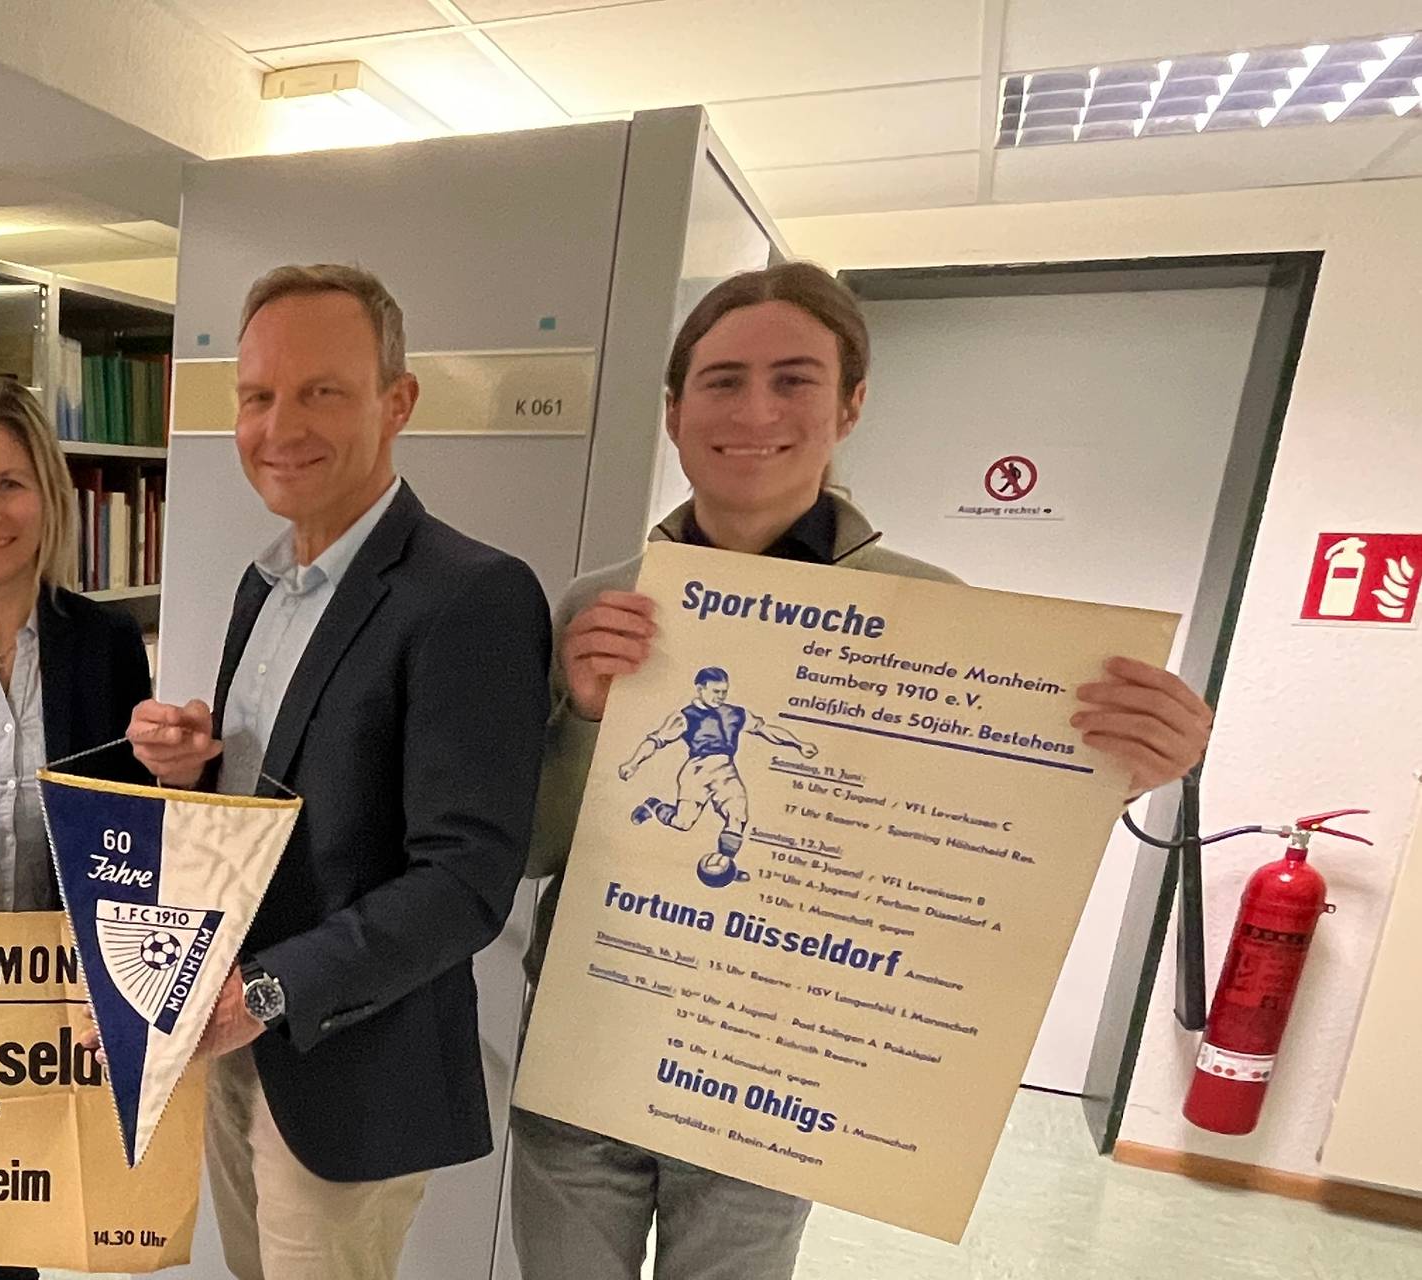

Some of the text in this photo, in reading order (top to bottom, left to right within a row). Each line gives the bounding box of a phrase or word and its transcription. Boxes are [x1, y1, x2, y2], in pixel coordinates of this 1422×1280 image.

[515, 398, 562, 416] K 061
[958, 505, 1040, 516] Ausgang rechts!
[683, 581, 884, 638] Sportwoche
[796, 665, 888, 697] Baumberg
[896, 682, 939, 702] 1910
[802, 640, 1066, 694] der Sportfreunde Monheim-
[871, 707, 903, 724] des
[907, 713, 973, 737] 50jähr.
[978, 724, 1075, 755] Bestehens
[792, 779, 804, 790] 16
[807, 782, 829, 795] Uhr
[931, 806, 998, 829] Leverkusen
[1002, 821, 1013, 832] C
[103, 829, 131, 854] 60
[784, 803, 798, 815] 17
[800, 807, 821, 819] Uhr
[825, 812, 870, 829] Reserve
[1011, 850, 1036, 865] Res.
[87, 854, 154, 889] Jahre
[771, 851, 787, 862] 10
[787, 854, 808, 867] Uhr
[907, 881, 973, 904] Leverkusen
[113, 907, 190, 926] 1. FC 1910
[759, 893, 774, 904] 15
[774, 896, 795, 909] Uhr
[808, 905, 874, 928] Mannschaft
[782, 873, 802, 886] Uhr
[876, 895, 920, 913] Fortuna
[925, 906, 987, 927] Düsseldorf
[990, 922, 1001, 932] A
[605, 882, 964, 991] Fortuna Düsseldorf Amateure
[165, 927, 214, 1012] MONHEIM
[703, 994, 722, 1006] Uhr
[867, 1038, 877, 1049] A
[726, 964, 746, 976] Uhr
[750, 970, 792, 989] Reserve
[806, 984, 832, 997] HSV
[910, 1012, 978, 1036] Mannschaft
[689, 1043, 708, 1056] Uhr
[721, 1053, 782, 1077] Mannschaft
[696, 1013, 716, 1026] Uhr
[720, 1020, 761, 1039] Reserve
[824, 1048, 868, 1068] Reserve
[657, 1058, 738, 1104] Union
[744, 1085, 837, 1133] Ohligs
[852, 1128, 917, 1152] Mannschaft
[728, 1129, 823, 1166] Rhein-Anlagen
[93, 1228, 168, 1248] 14.30 Uhr
